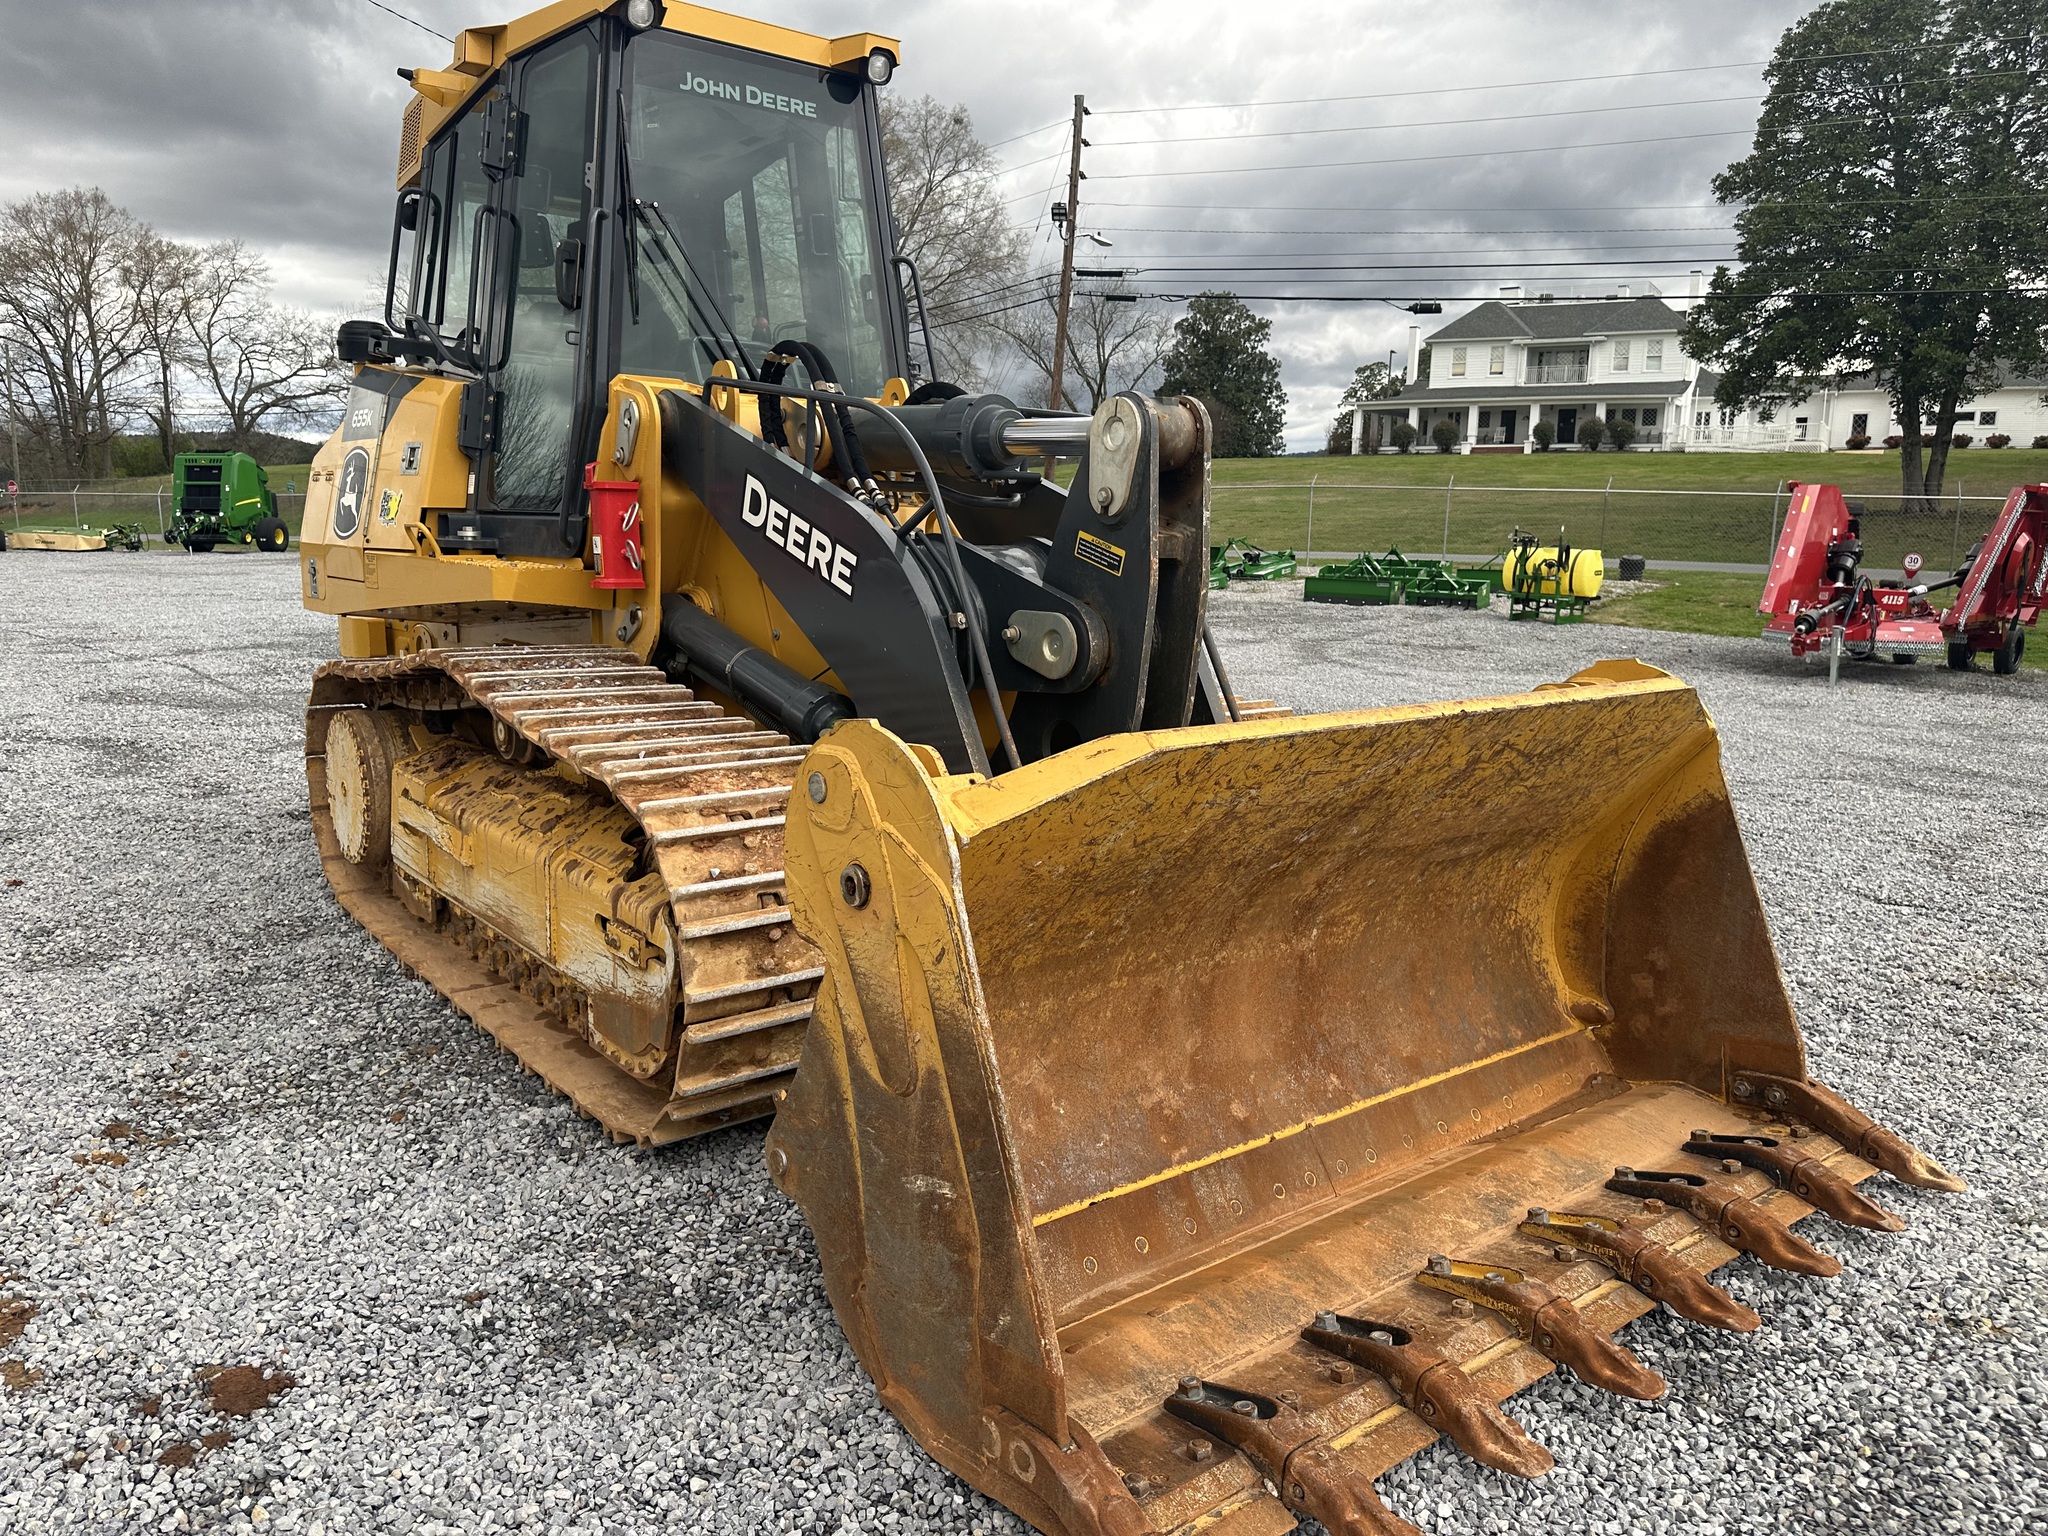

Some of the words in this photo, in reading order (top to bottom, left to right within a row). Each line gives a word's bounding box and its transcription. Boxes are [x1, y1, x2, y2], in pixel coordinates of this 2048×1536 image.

[679, 71, 740, 102] JOHN
[745, 84, 817, 118] DEERE
[351, 408, 373, 428] 655K
[741, 473, 858, 596] DEERE
[1907, 556, 1919, 565] 30
[1881, 595, 1905, 605] 4115
